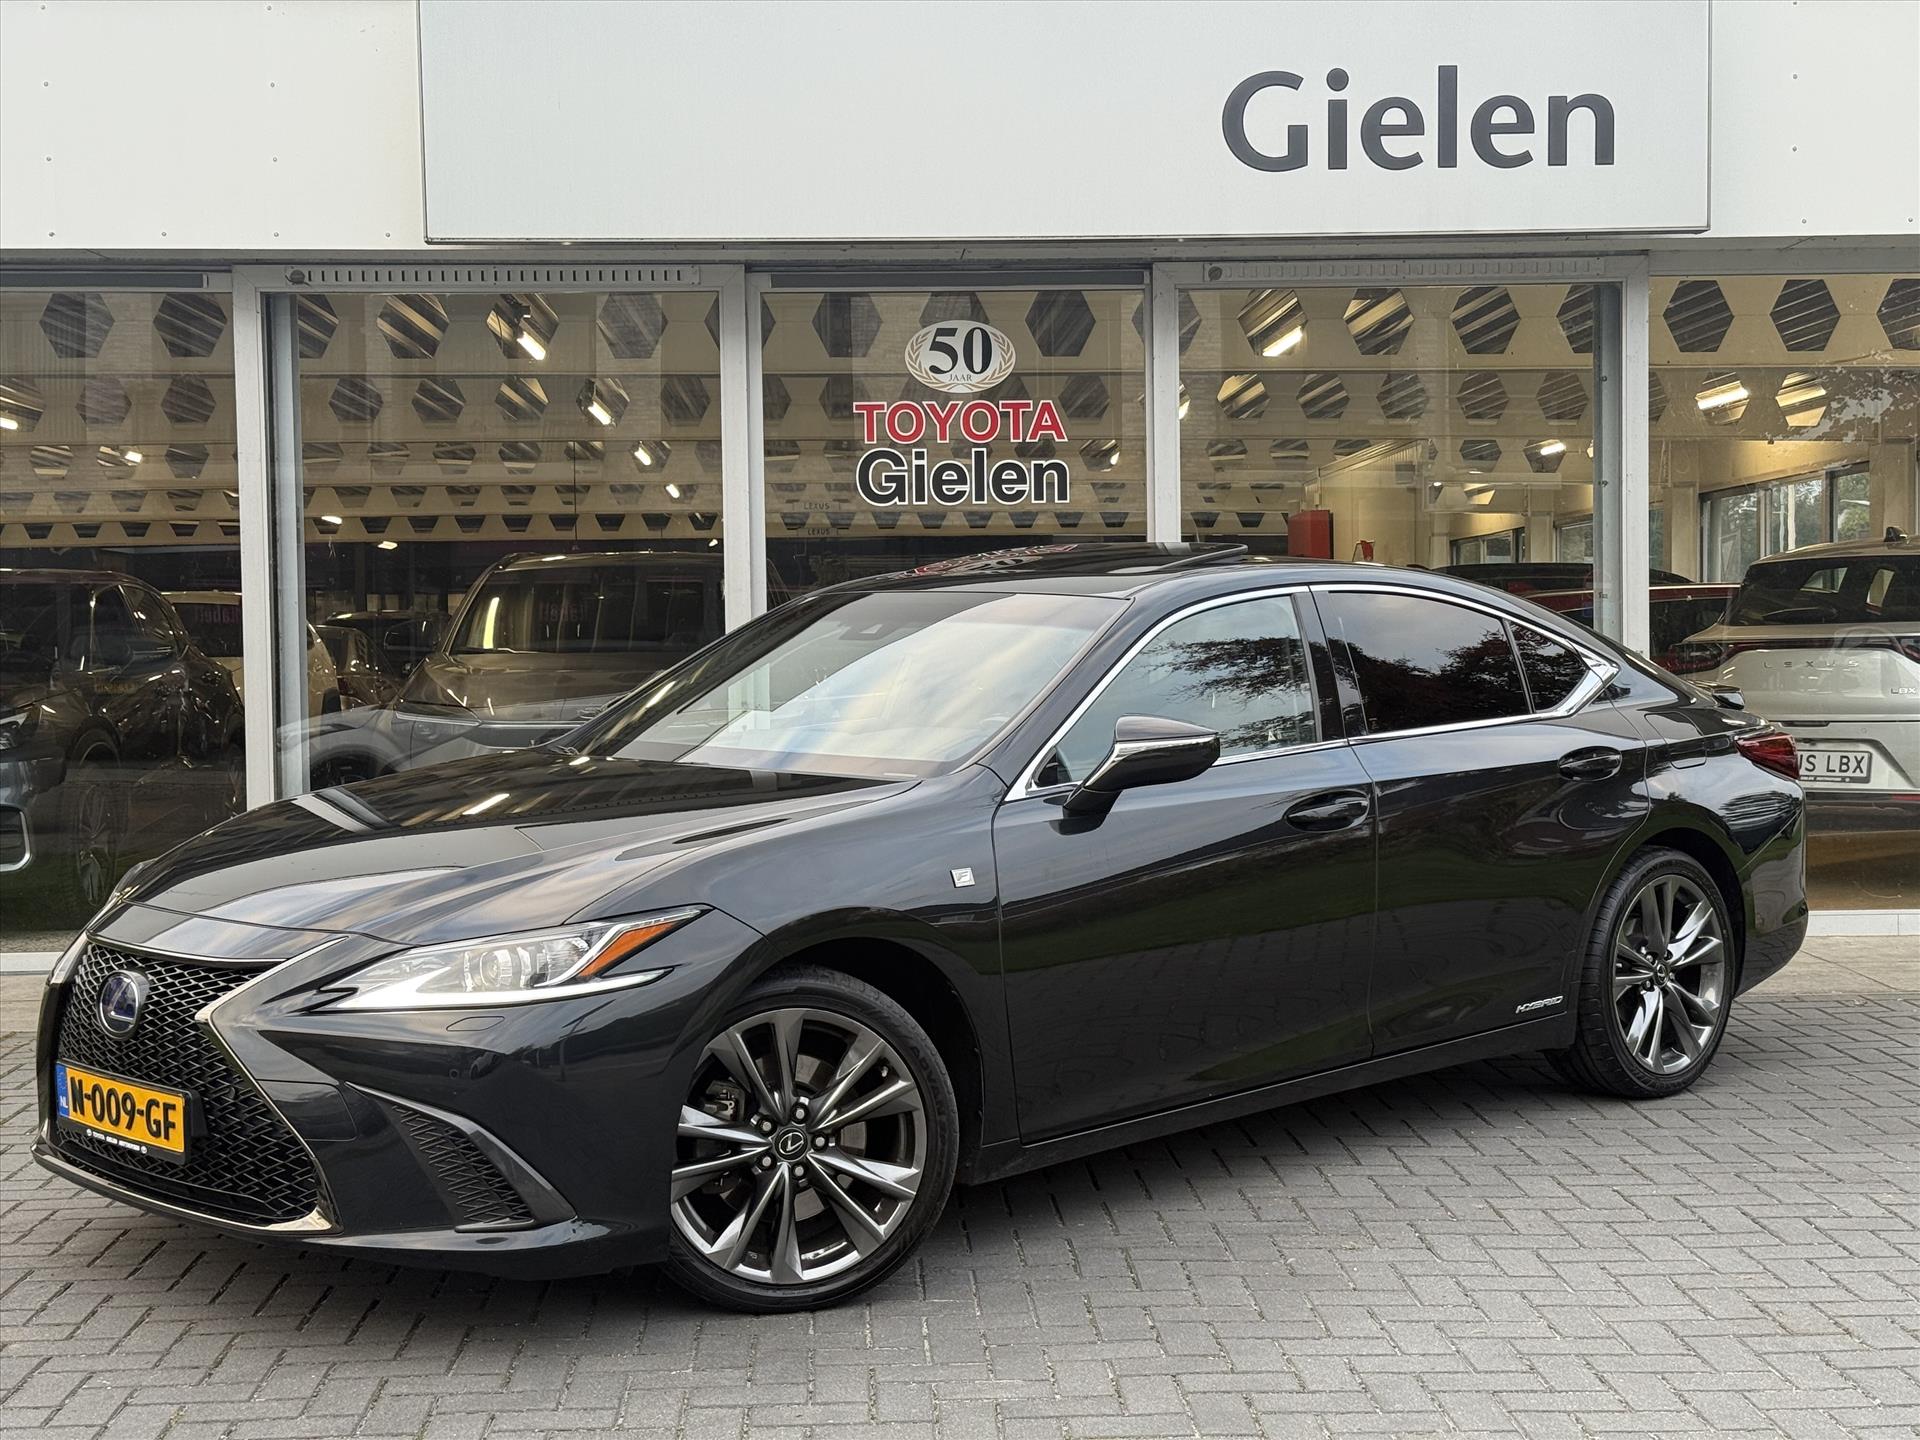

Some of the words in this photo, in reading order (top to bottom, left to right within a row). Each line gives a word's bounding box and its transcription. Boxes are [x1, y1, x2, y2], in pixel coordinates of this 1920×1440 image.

[1221, 64, 1615, 172] Gielen
[929, 327, 992, 374] 50
[948, 374, 973, 382] JAAR
[853, 400, 1068, 444] TOYOTA
[856, 448, 1070, 506] Gielen
[803, 502, 830, 510] LEXUS
[807, 528, 830, 536] LEXUS
[1763, 660, 1859, 669] LEXUS
[1891, 687, 1917, 695] LBX
[1826, 755, 1865, 774] LBX
[1515, 995, 1564, 1014] HYBRID
[60, 1096, 68, 1109] NL
[70, 1076, 177, 1141] N-009-GF
